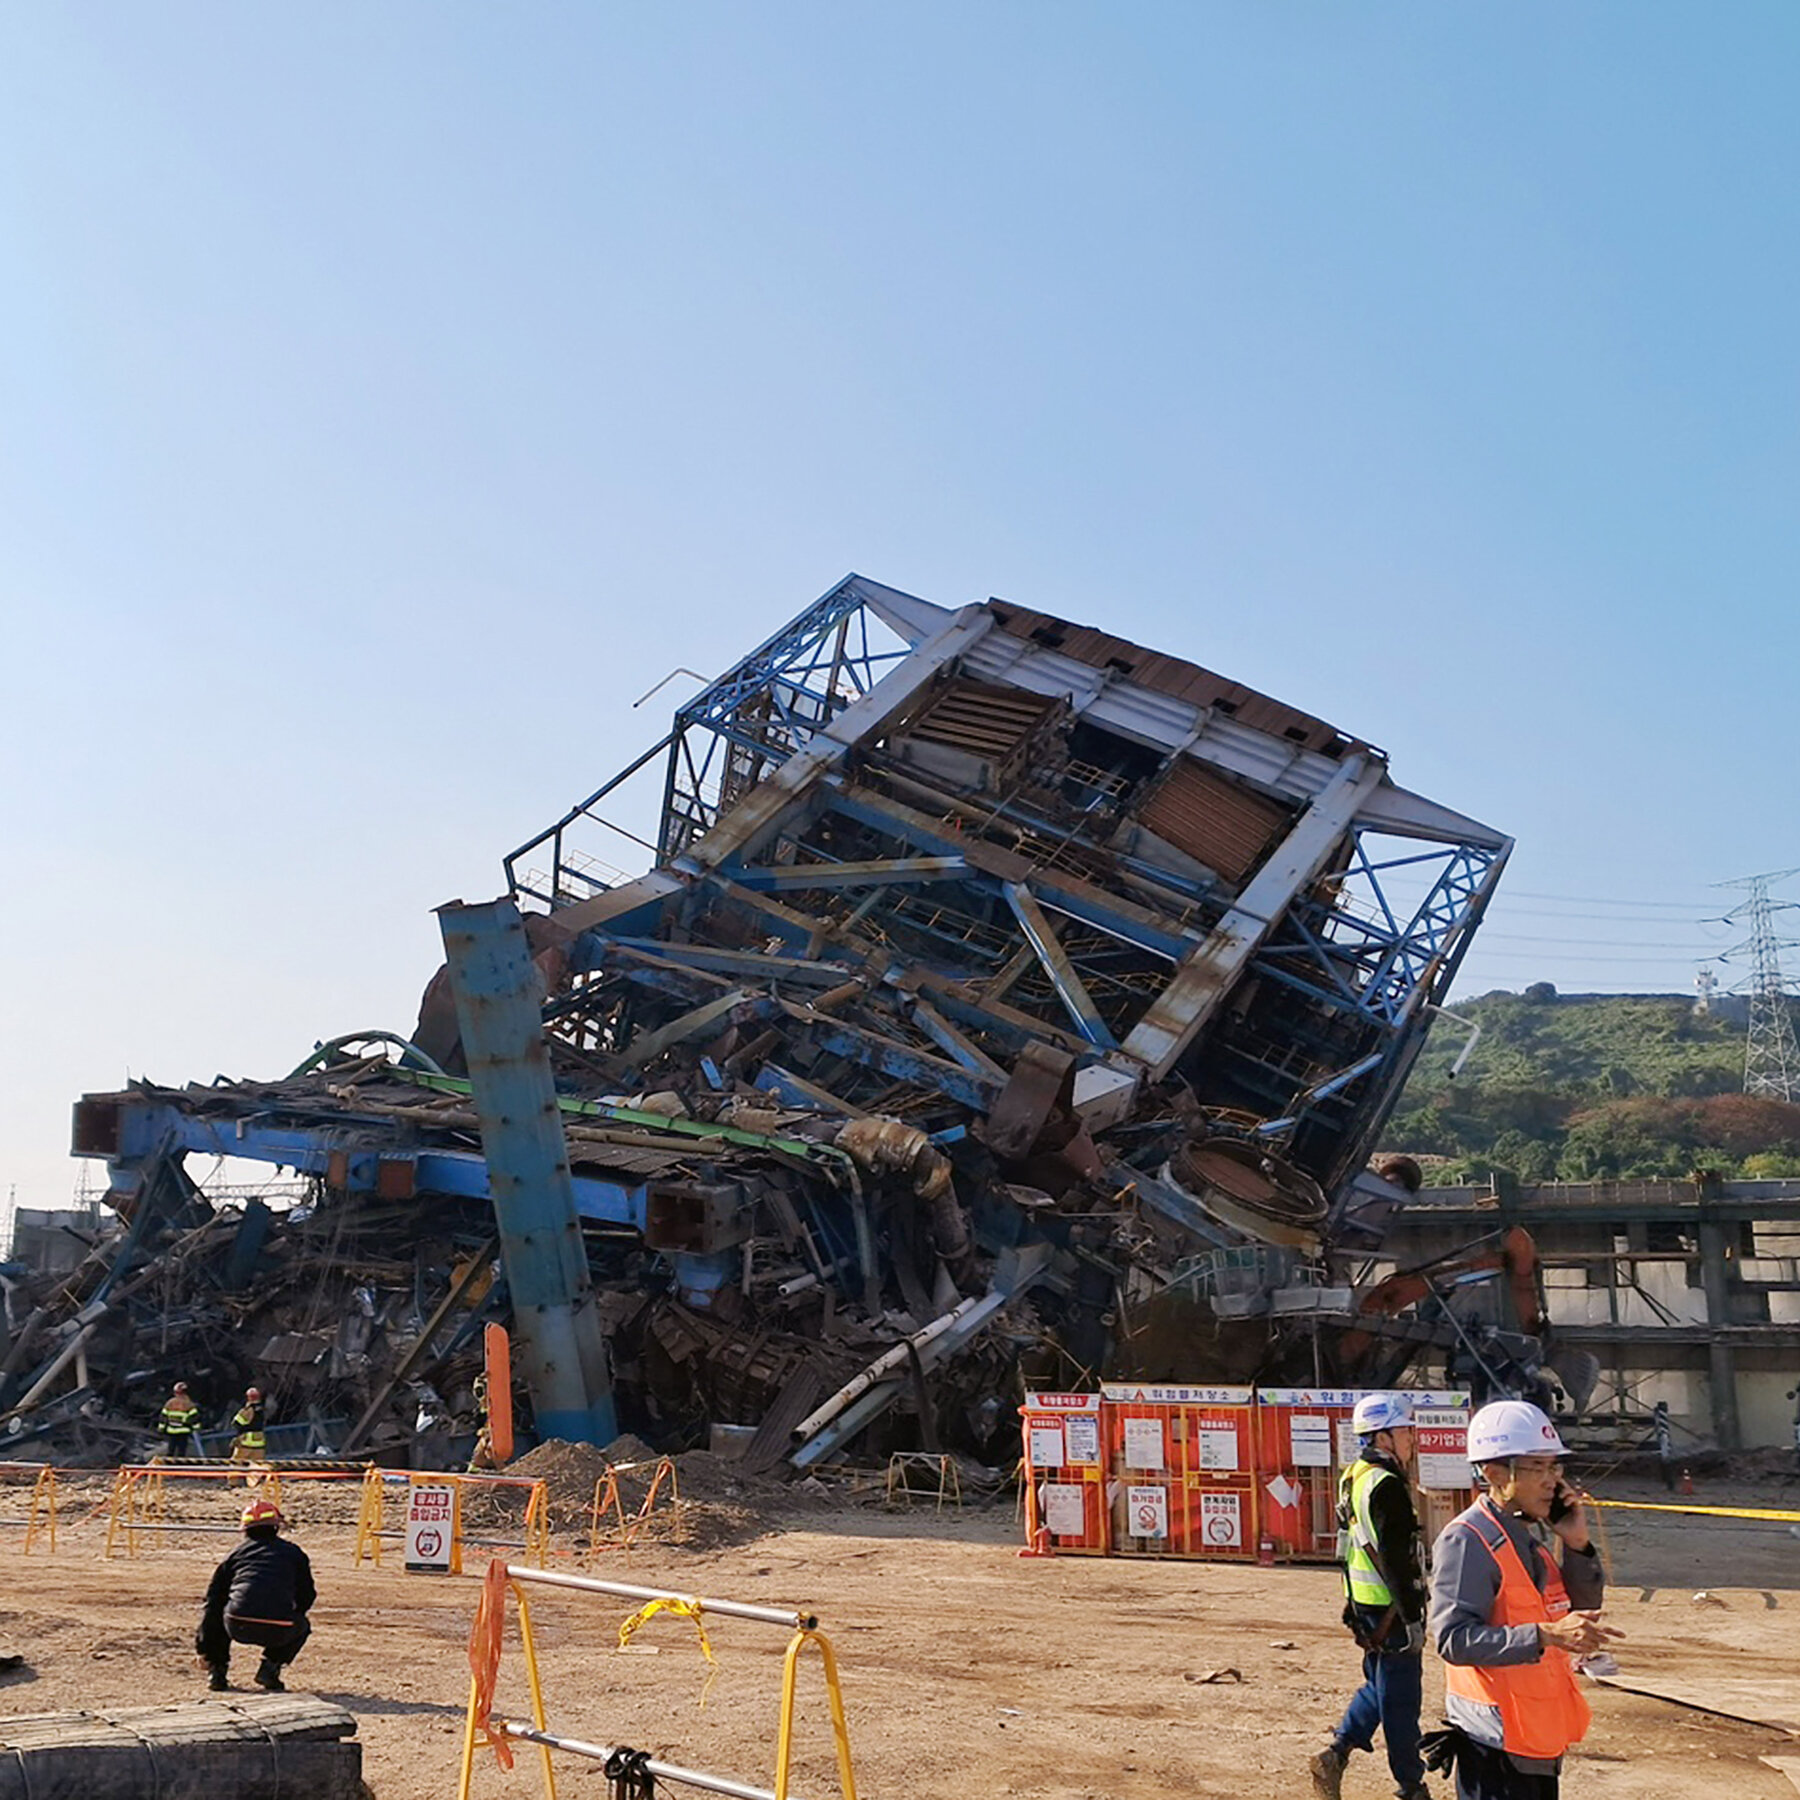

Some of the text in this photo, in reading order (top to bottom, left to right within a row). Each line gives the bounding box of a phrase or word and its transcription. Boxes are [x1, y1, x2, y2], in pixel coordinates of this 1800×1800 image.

[1152, 1388, 1230, 1400] 위험물저장소
[1419, 1432, 1466, 1448] 화기엄금
[410, 1507, 451, 1521] 출입금지
